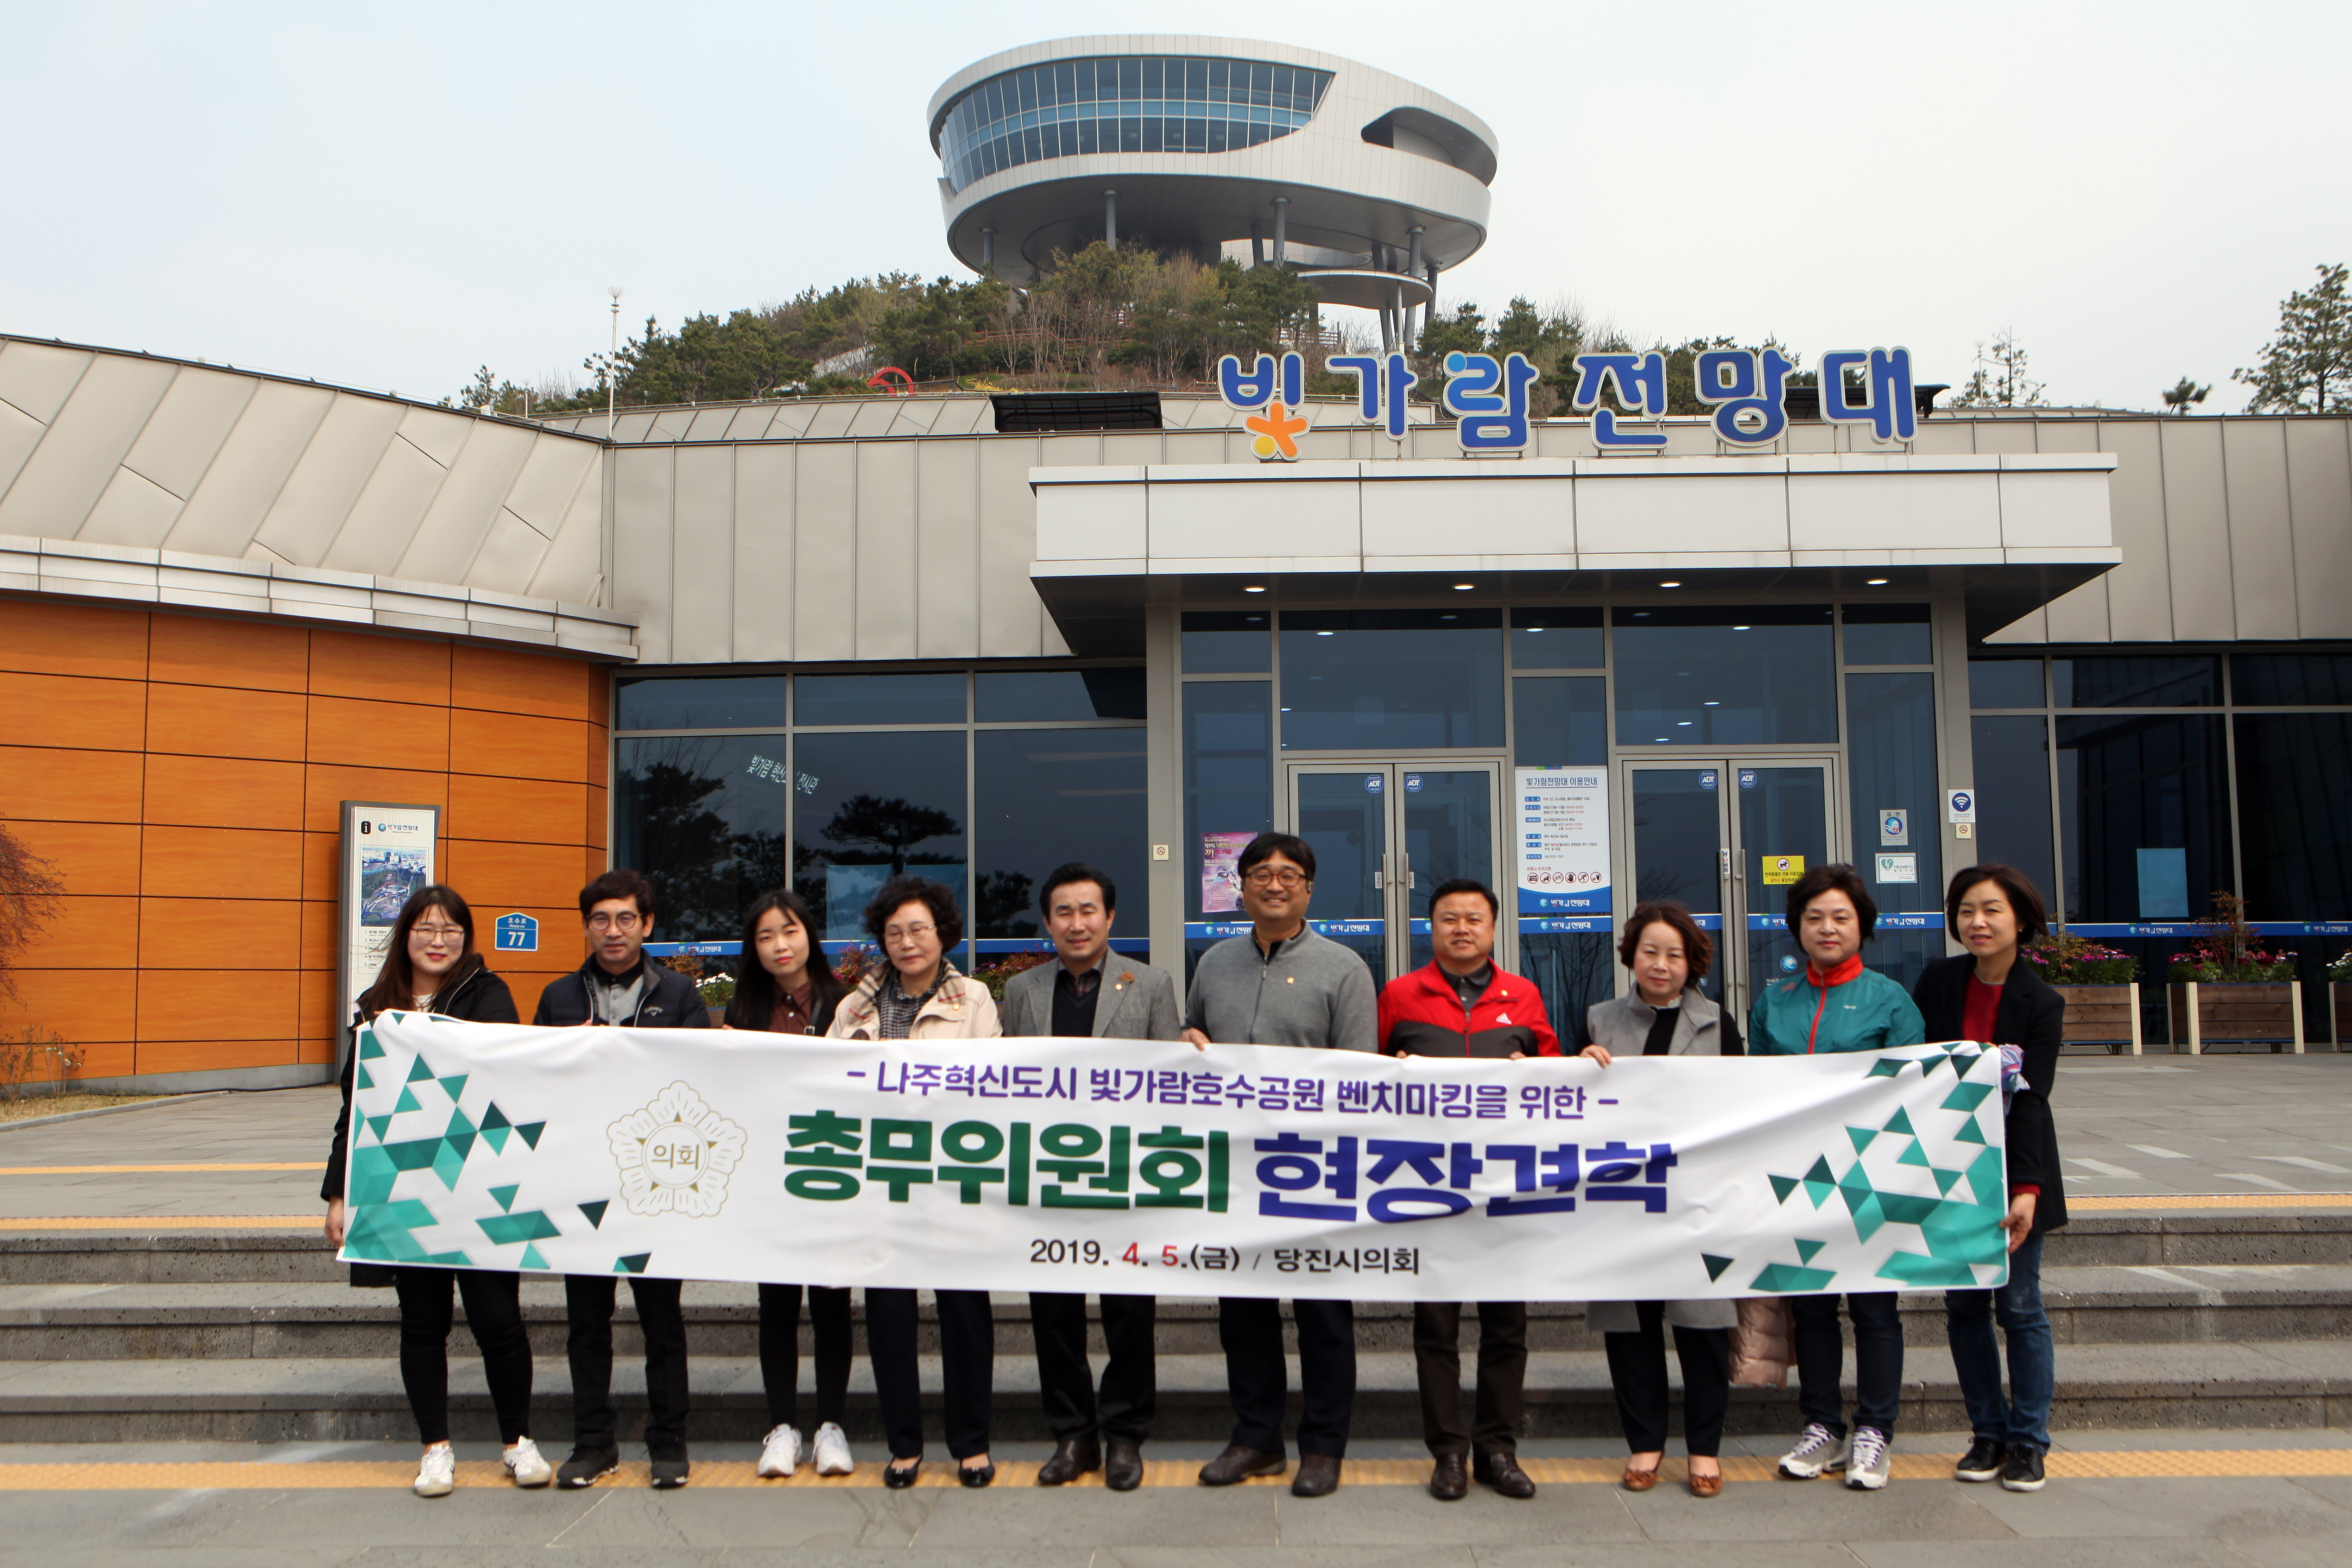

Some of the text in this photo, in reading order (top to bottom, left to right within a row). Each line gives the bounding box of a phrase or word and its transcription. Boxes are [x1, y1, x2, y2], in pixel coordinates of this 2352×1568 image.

[747, 755, 775, 778] 빛가람
[1526, 777, 1598, 786] 빛가람전망대 이용안내
[508, 931, 525, 946] 77
[877, 1061, 1077, 1101] 나주혁신도시
[1090, 1068, 1325, 1113] 빛가람호수공원
[1336, 1079, 1508, 1120] 벤치마킹을
[1519, 1084, 1587, 1120] 위한
[651, 1143, 700, 1170] 의회
[784, 1109, 1678, 1224] 총무위원회 현장견학
[1030, 1239, 1109, 1266] 2019.
[1122, 1242, 1149, 1267] 4.
[1274, 1247, 1420, 1276] 당진시의회
